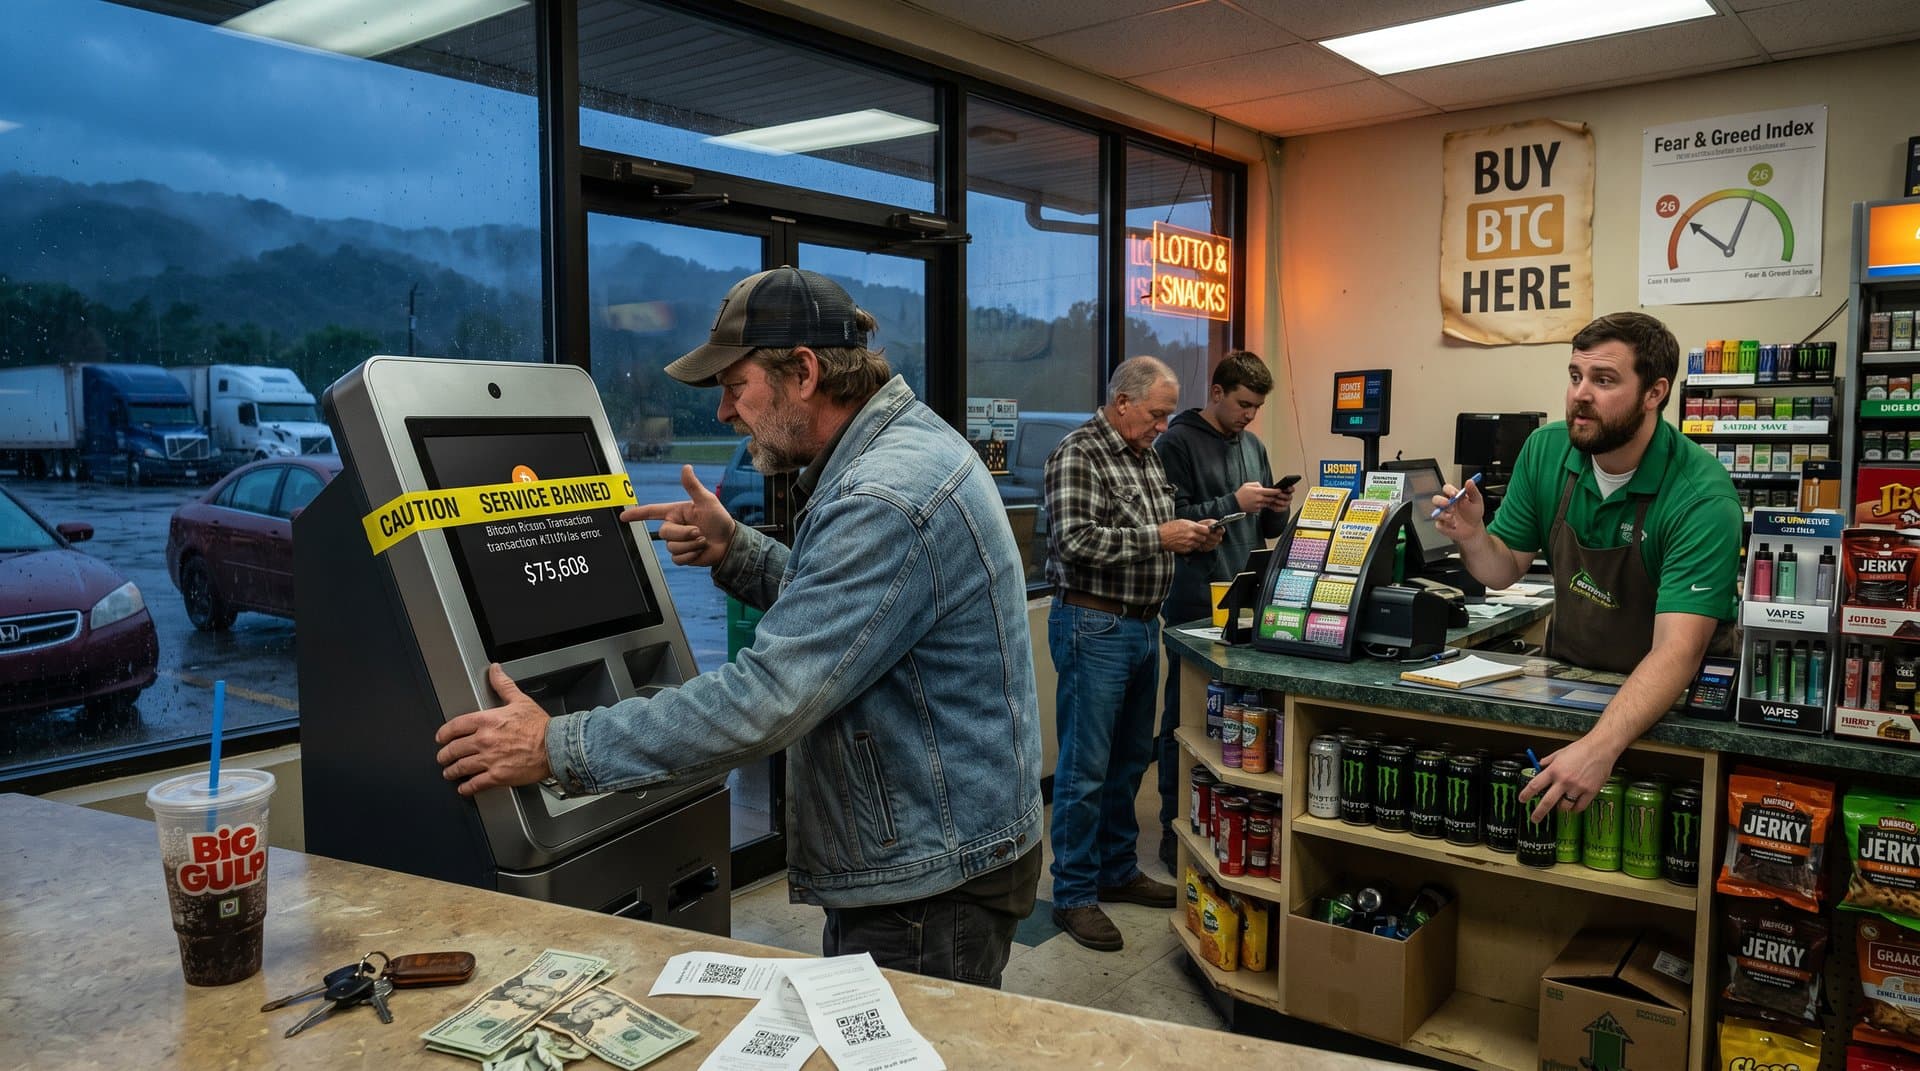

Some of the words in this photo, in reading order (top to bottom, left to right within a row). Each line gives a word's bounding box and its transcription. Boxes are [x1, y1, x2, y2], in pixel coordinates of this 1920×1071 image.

[1654, 136, 1690, 153] Fear
[1694, 131, 1707, 148] &
[1711, 124, 1761, 145] Greed
[1766, 120, 1814, 140] Index
[1474, 141, 1561, 195] BUY
[1752, 169, 1769, 182] 26
[1659, 201, 1676, 212] 26
[1477, 203, 1554, 254] BTC
[1159, 232, 1214, 271] LOTTO
[1215, 245, 1227, 273] &
[1462, 264, 1571, 314] HERE
[1745, 271, 1760, 279] Fear
[1768, 269, 1791, 277] Greed
[1160, 275, 1226, 312] SNACKS
[379, 496, 460, 537] CAUTION
[479, 487, 550, 514] SERVICE
[550, 482, 611, 506] BANNED
[486, 523, 517, 537] Bitcoin
[546, 514, 593, 528] Transaction
[487, 537, 538, 552] transaction
[524, 555, 589, 586] $75,608
[1858, 559, 1908, 573] JERKY
[1766, 608, 1805, 620] VAPES
[1760, 705, 1799, 719] VAPES
[1743, 814, 1807, 843] JERKY
[180, 851, 265, 892] GULP
[1742, 937, 1806, 967] JERKY
